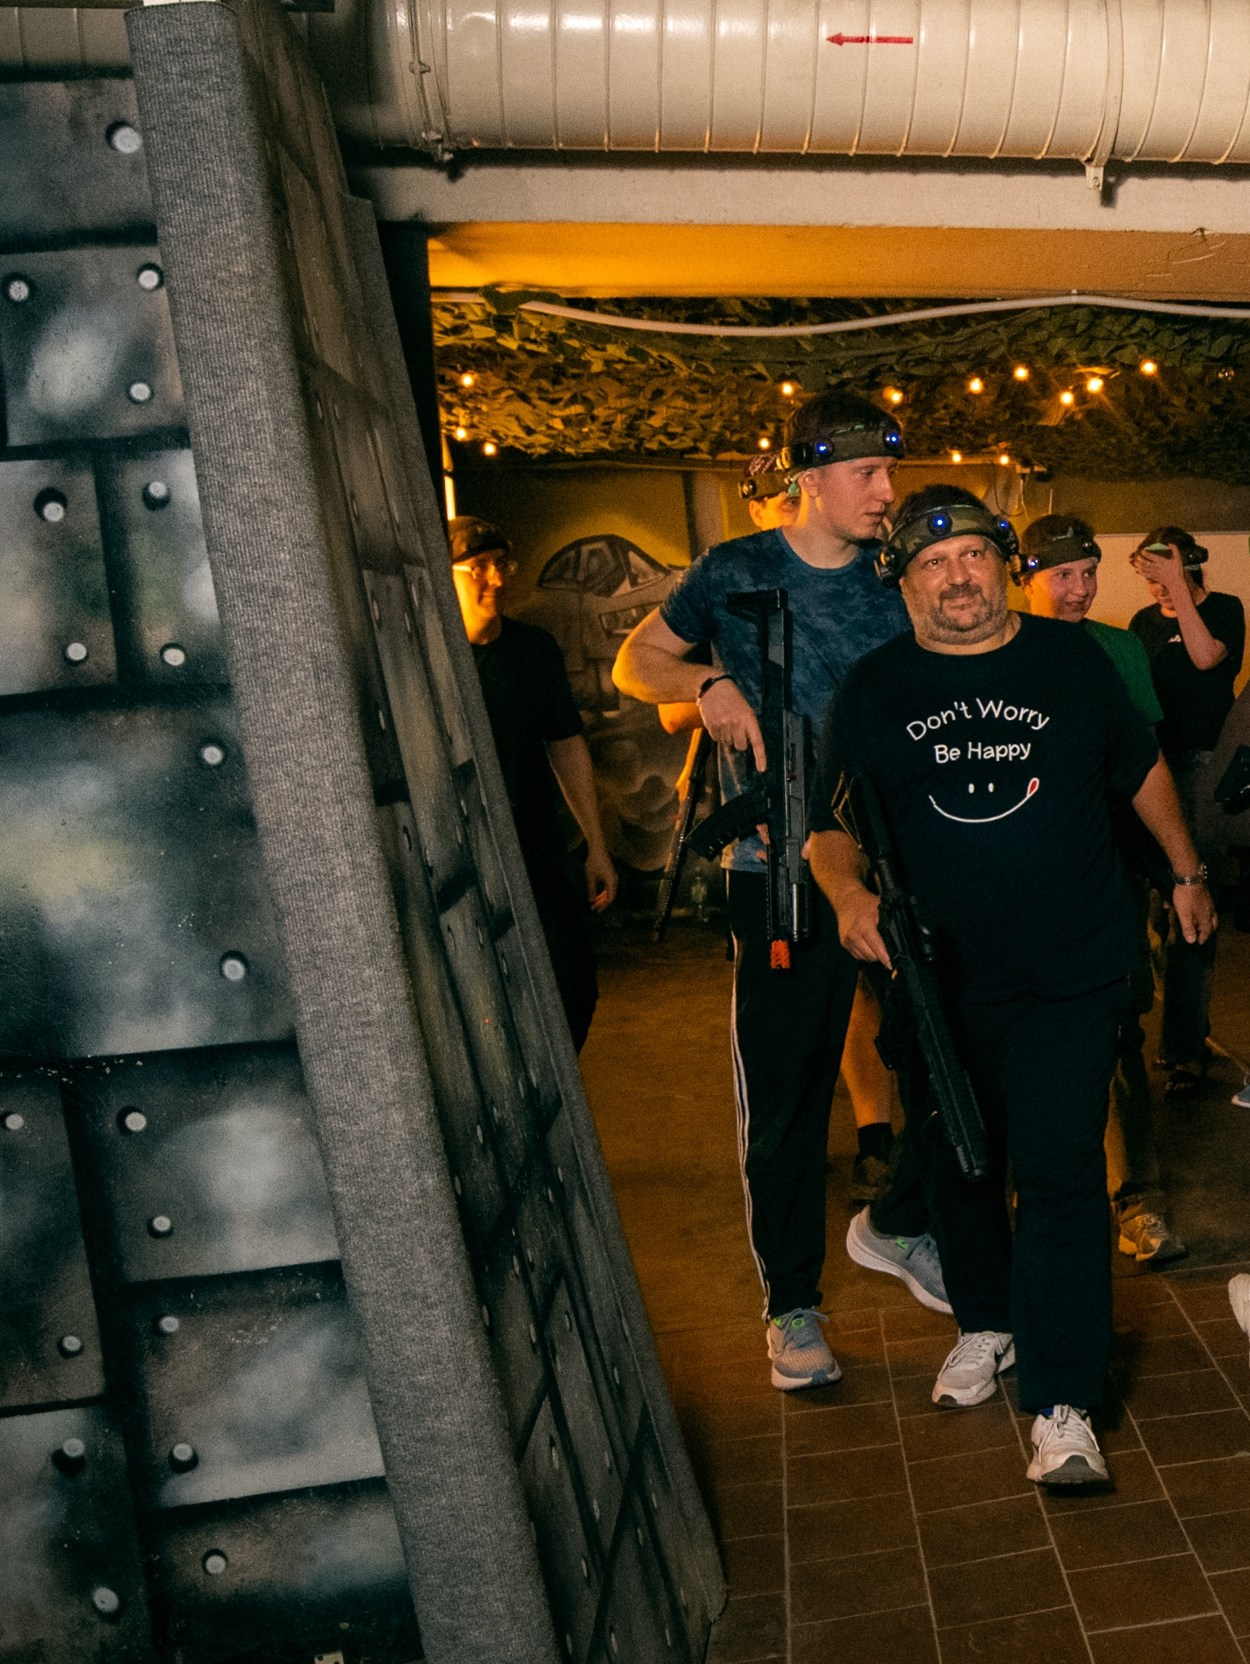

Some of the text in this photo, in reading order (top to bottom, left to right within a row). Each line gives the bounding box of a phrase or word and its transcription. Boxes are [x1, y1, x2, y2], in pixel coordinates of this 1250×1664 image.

[906, 697, 1050, 741] Don't Worry
[934, 741, 1032, 764] Be Happy
